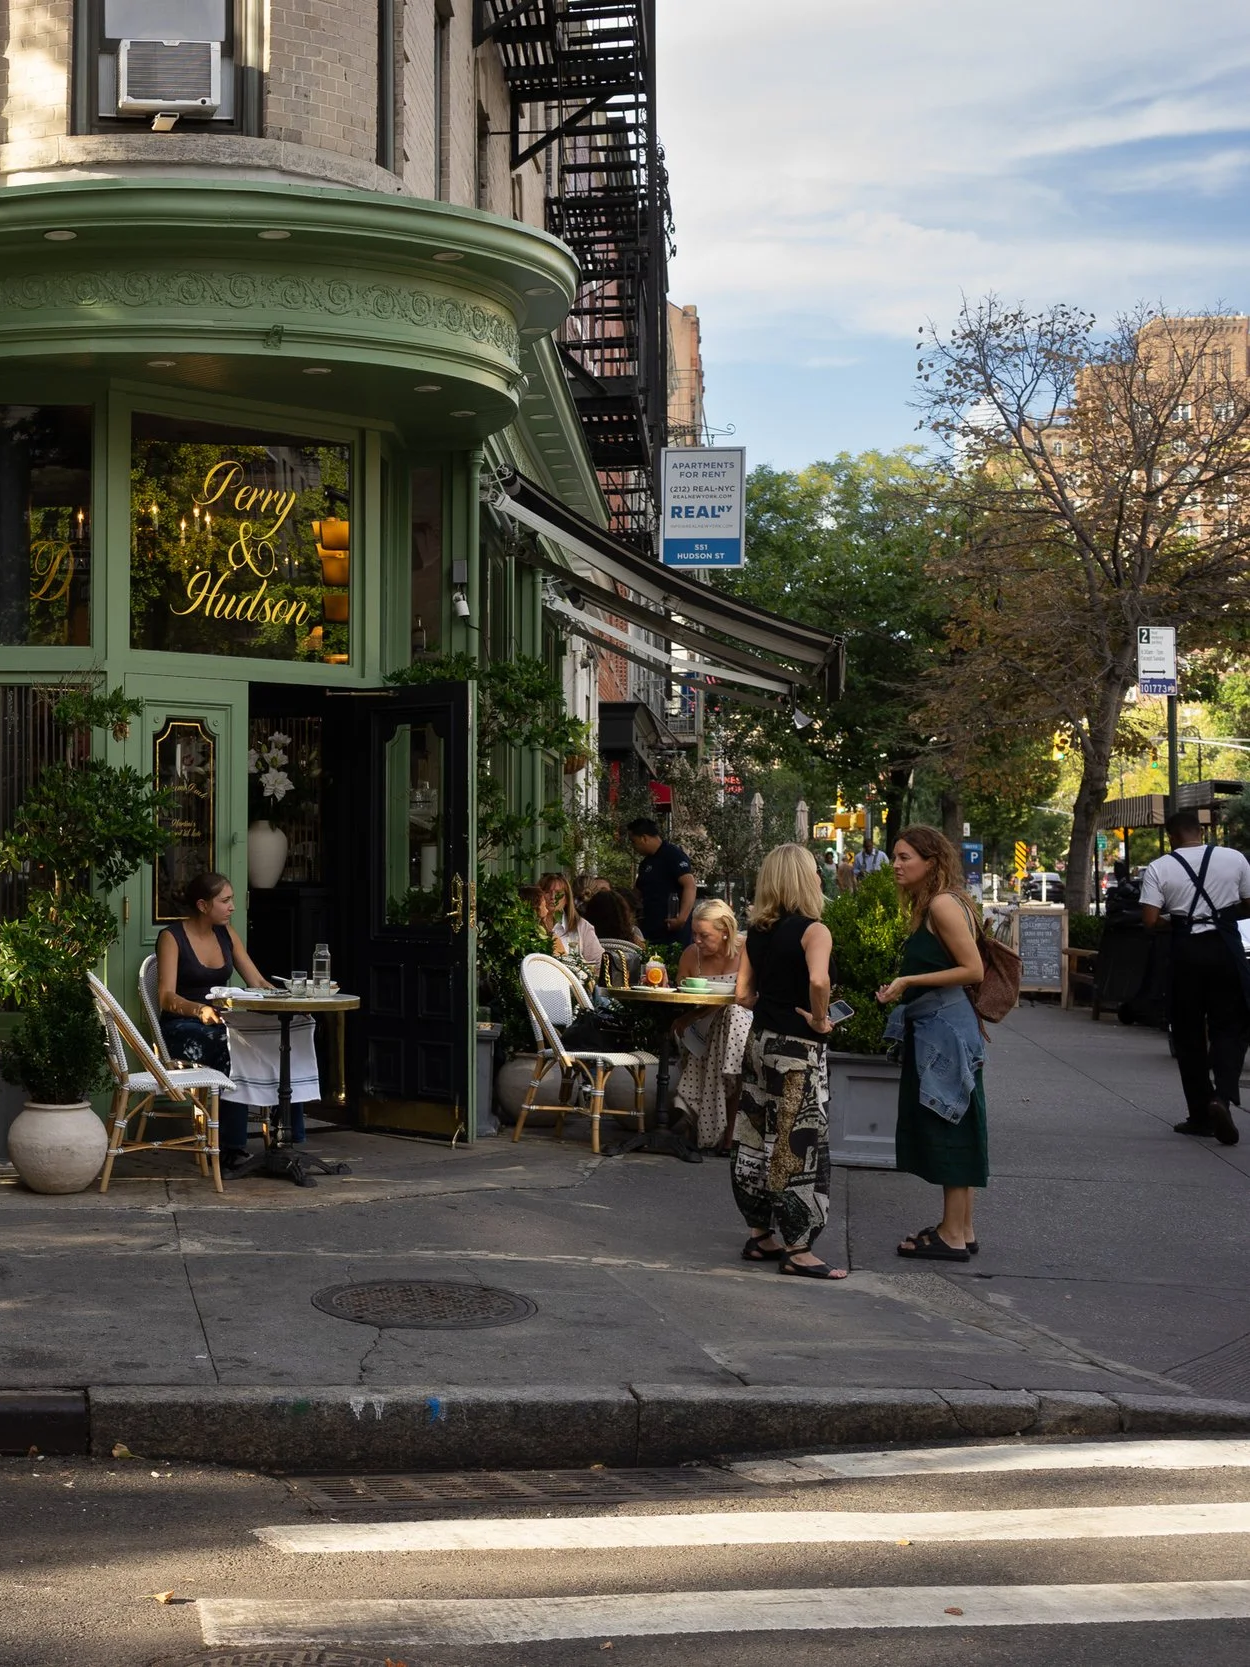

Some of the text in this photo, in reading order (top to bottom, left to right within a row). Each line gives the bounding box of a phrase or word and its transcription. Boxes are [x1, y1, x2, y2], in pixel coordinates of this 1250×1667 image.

[672, 462, 735, 470] APARTMENTS
[191, 460, 296, 540] Perry
[228, 522, 275, 577] &
[677, 552, 712, 560] HUDSON
[169, 570, 313, 626] Hudson
[1141, 629, 1148, 643] 2
